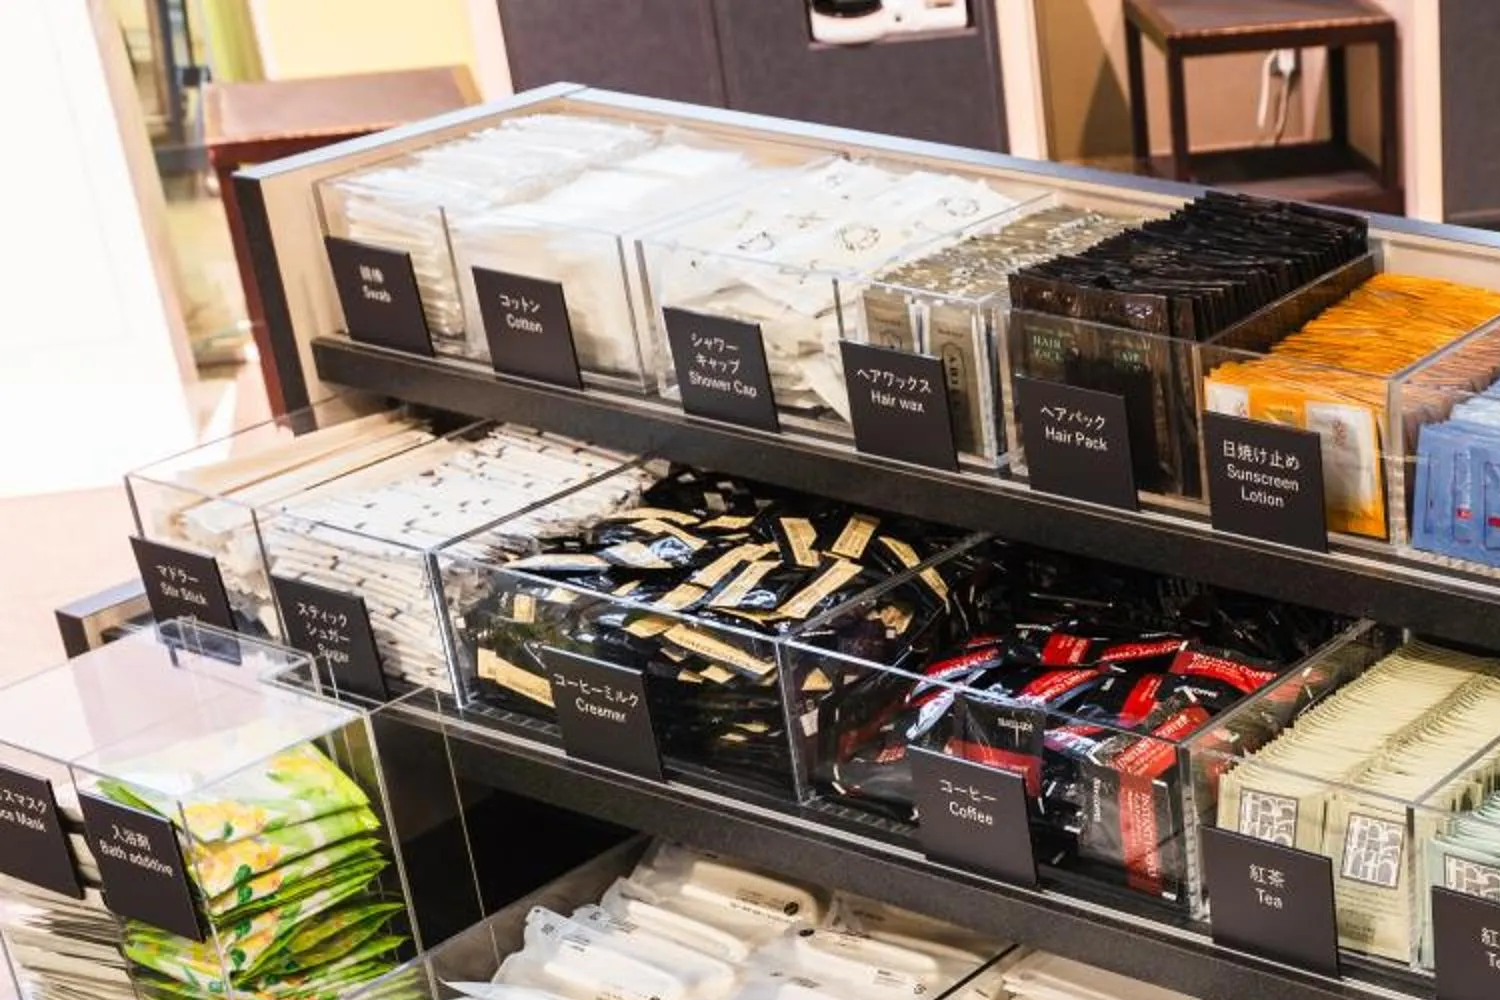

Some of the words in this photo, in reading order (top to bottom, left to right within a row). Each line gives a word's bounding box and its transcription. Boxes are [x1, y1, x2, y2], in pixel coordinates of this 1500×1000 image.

[499, 293, 541, 313] コットン
[506, 313, 544, 334] Cotton
[690, 333, 739, 352] シャワー
[696, 353, 740, 373] キャップ
[689, 370, 731, 392] Shower
[733, 379, 757, 398] Cap
[855, 368, 932, 394] ヘアワックス
[871, 390, 896, 409] Hair
[899, 398, 925, 413] wax
[1040, 405, 1106, 429] ヘアパック
[1045, 426, 1073, 444] Hair
[1074, 433, 1108, 452] Pack
[1223, 439, 1299, 470] 日焼け止め
[1226, 464, 1299, 492] Sunscreen
[1241, 487, 1284, 507] Lotion
[156, 565, 199, 583] マドラー
[297, 602, 348, 627] スティック
[306, 622, 350, 641] シュガー
[553, 673, 639, 708] コーヒーミルク
[575, 697, 627, 723] Creamer
[0, 789, 47, 814] スマスク
[940, 779, 997, 801] コーヒー
[949, 801, 993, 825] Coffee
[99, 838, 127, 860] Bath
[1249, 863, 1285, 888] 紅茶
[1256, 887, 1283, 909] Tea
